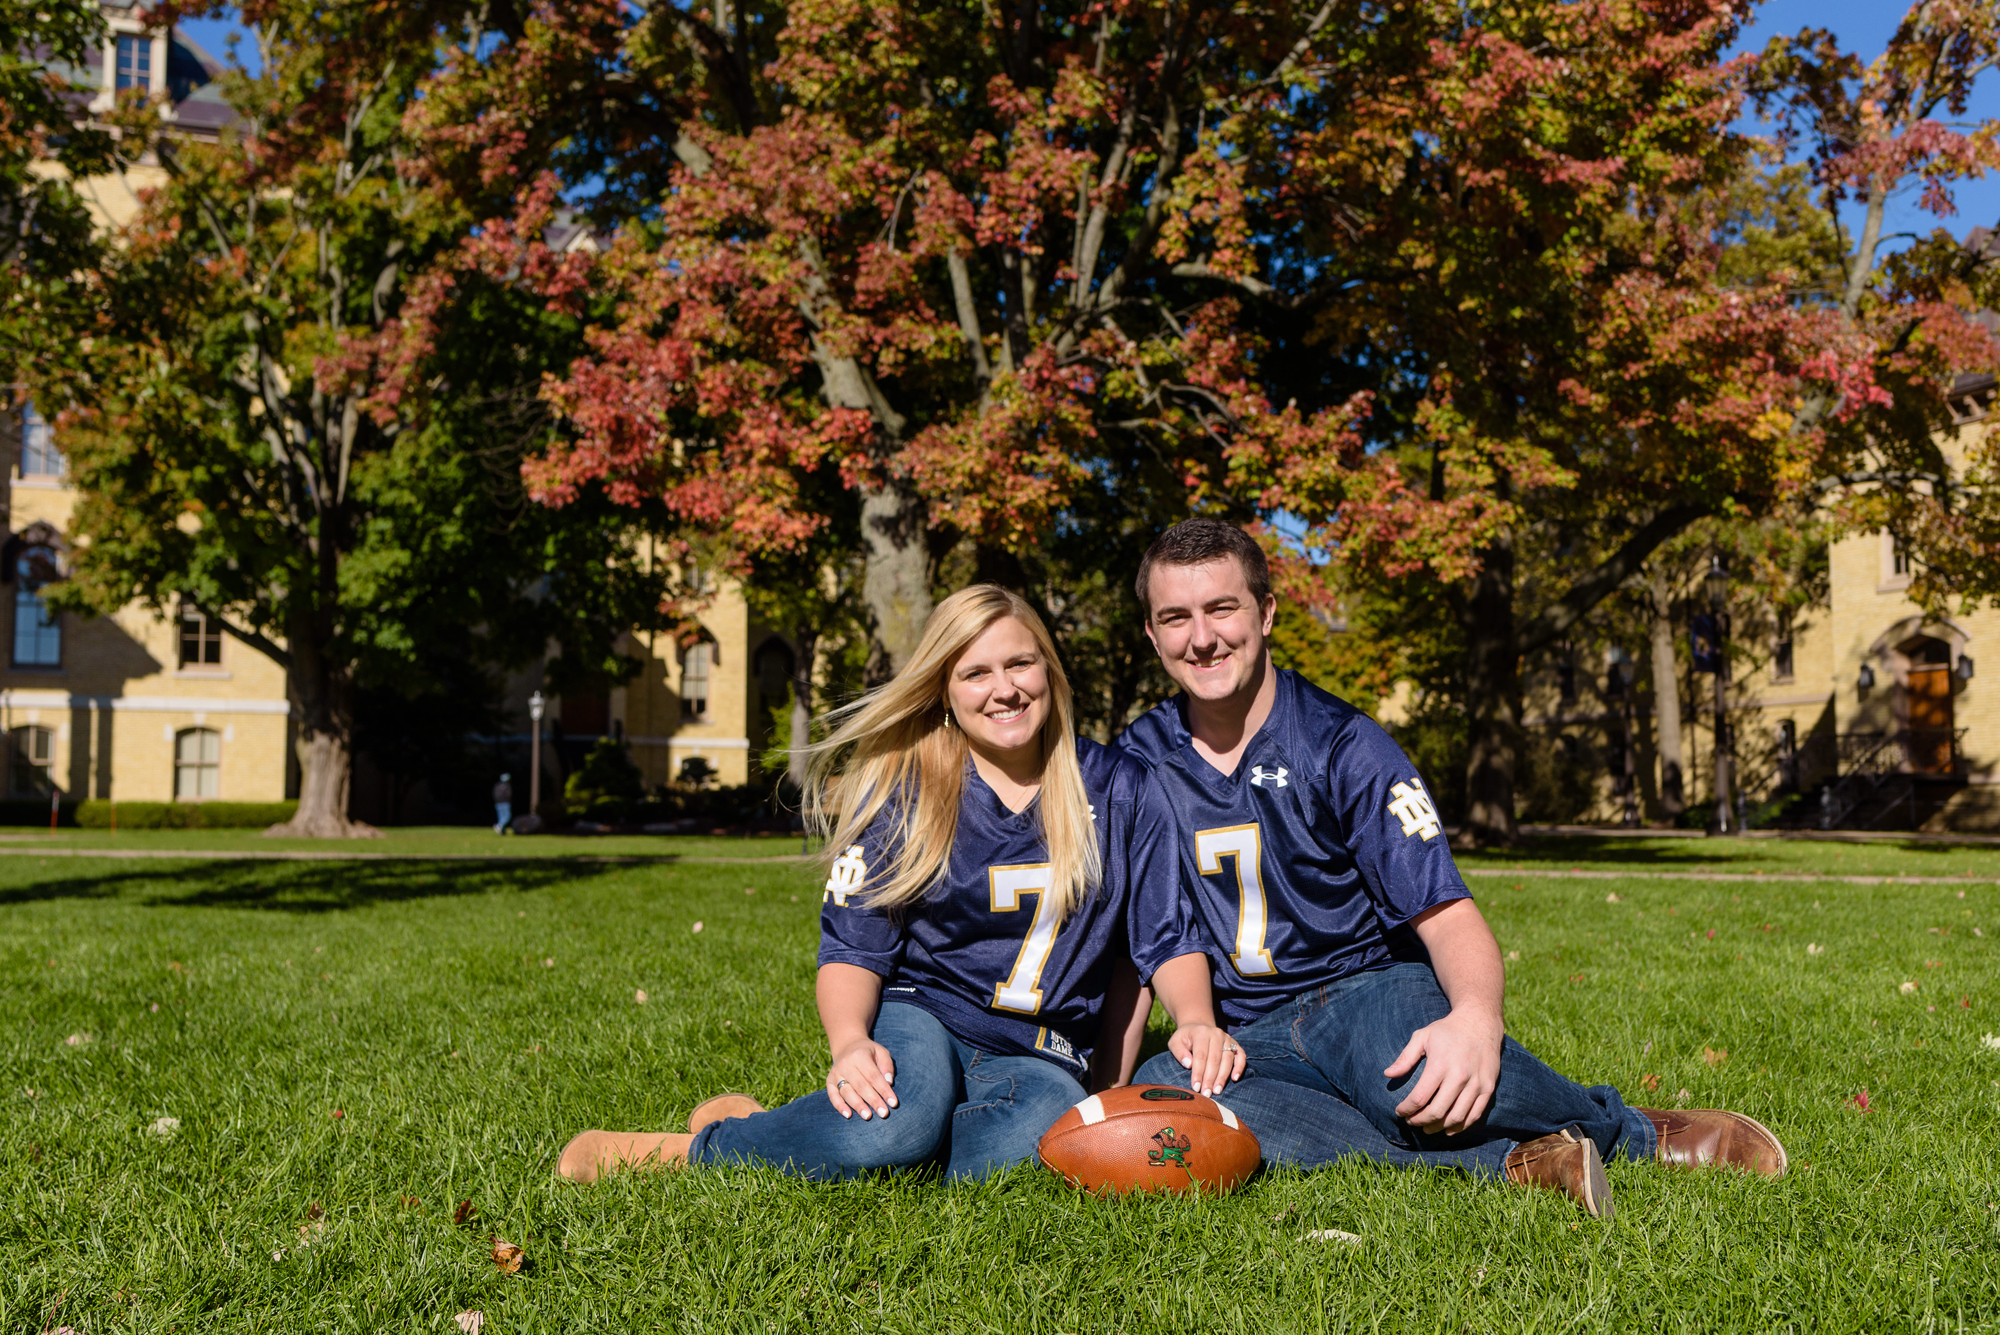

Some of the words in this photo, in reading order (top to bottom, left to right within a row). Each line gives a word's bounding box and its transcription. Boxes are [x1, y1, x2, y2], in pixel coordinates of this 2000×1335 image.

[1195, 823, 1278, 977] 7
[988, 863, 1061, 1016] 7
[1051, 1030, 1072, 1049] NOTRE
[1051, 1040, 1073, 1057] DAME
[1145, 1089, 1192, 1100] GST
